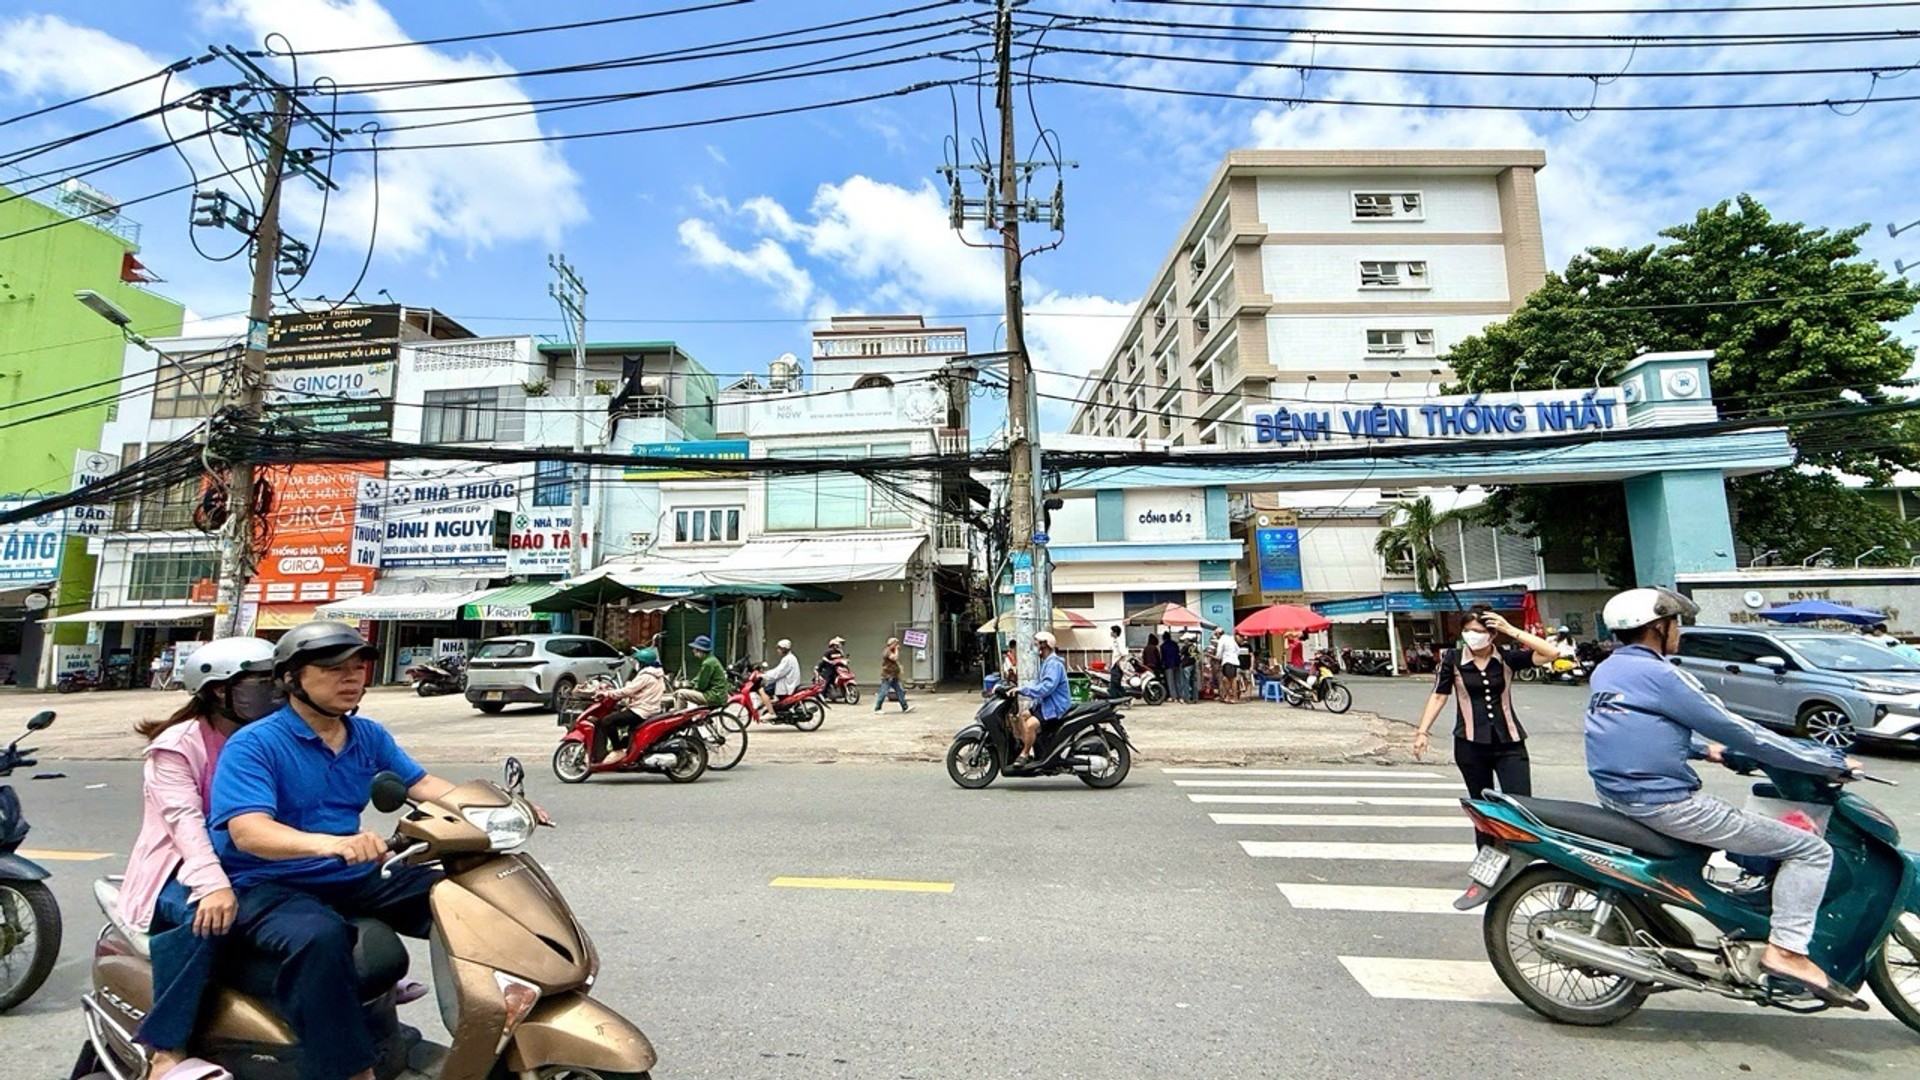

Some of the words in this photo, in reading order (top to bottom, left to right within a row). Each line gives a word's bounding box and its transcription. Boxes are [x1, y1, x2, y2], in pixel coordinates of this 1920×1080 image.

[333, 318, 372, 329] GROUP
[293, 373, 363, 392] GINCI10
[1255, 407, 1331, 447] BỆNH
[1343, 402, 1410, 443] VIỆN
[1420, 393, 1526, 436] THỐNG
[1537, 387, 1617, 432] NHẤT
[415, 483, 450, 501] NHÀ
[457, 481, 515, 499] THUỐC
[555, 517, 572, 528] THU
[1185, 513, 1191, 523] 2
[387, 518, 429, 539] BÌNH
[434, 519, 495, 538] NGUY
[0, 529, 57, 560] ÁNG
[511, 528, 544, 549] BẢO
[281, 559, 320, 572] CIRCA
